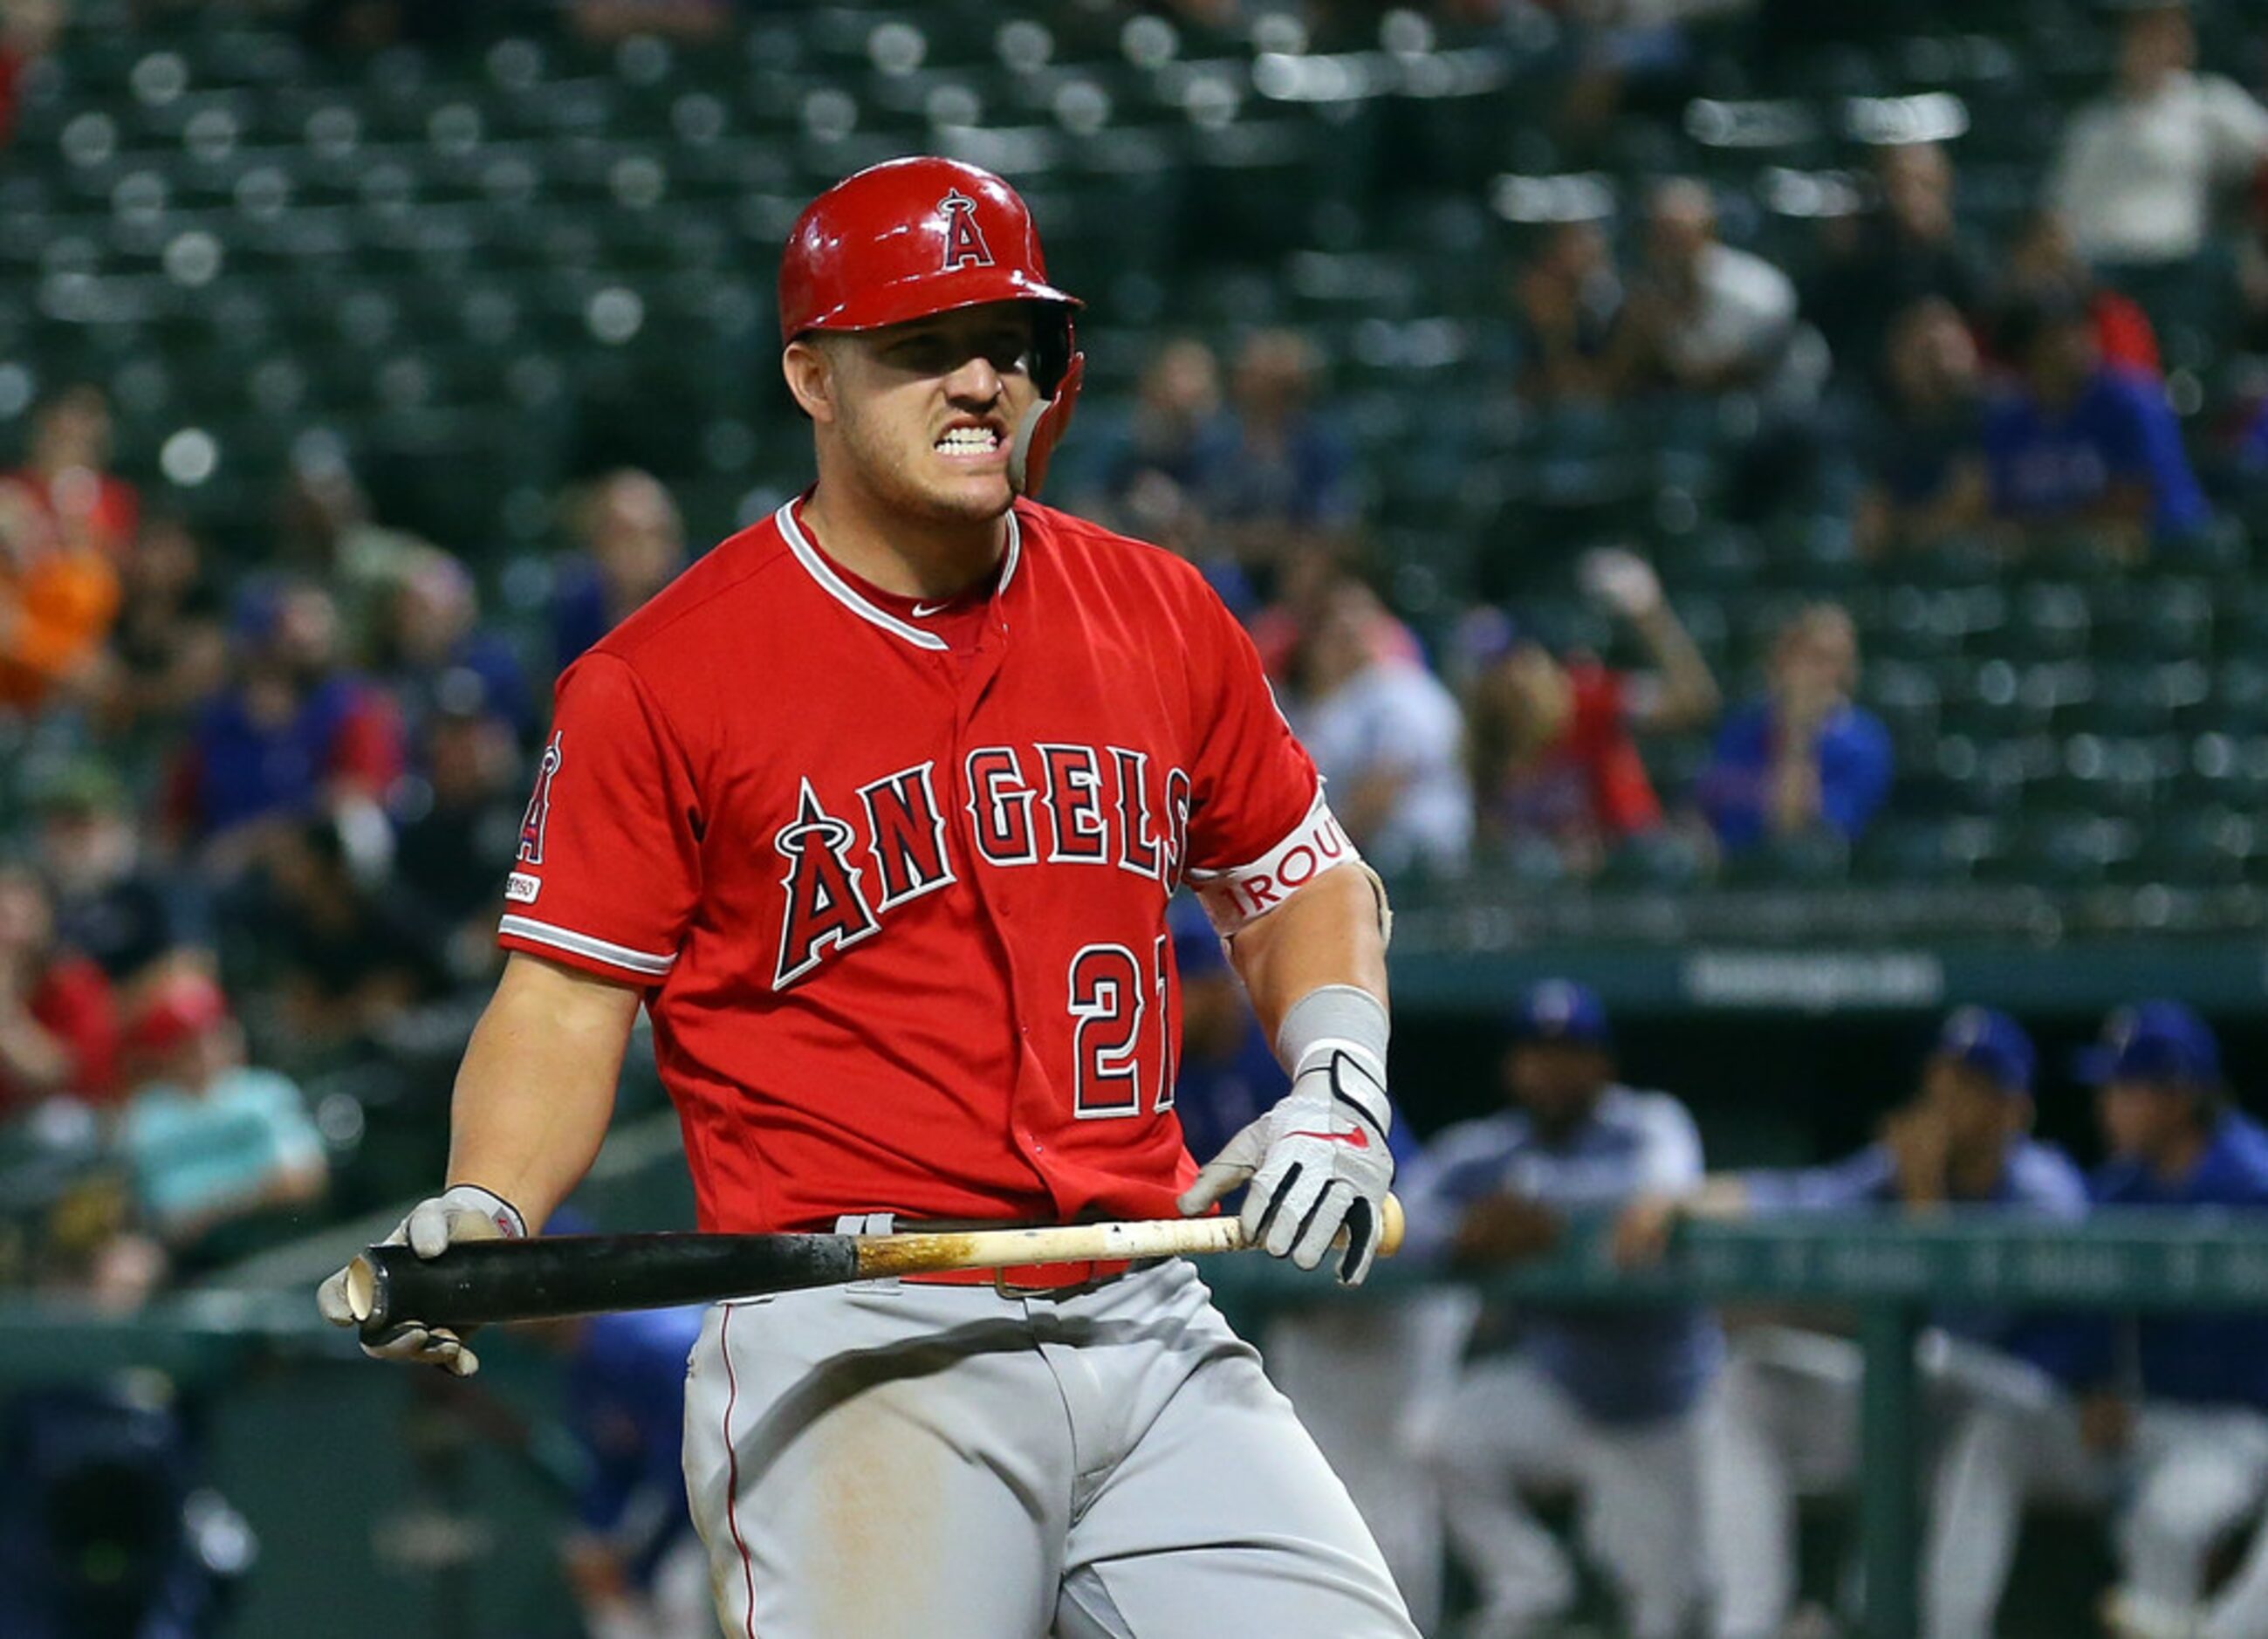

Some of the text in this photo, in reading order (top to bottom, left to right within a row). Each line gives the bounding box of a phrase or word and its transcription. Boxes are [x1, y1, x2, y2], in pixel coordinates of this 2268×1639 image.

[937, 188, 995, 271] A
[516, 730, 563, 864] A
[772, 742, 1190, 991] ANGELS
